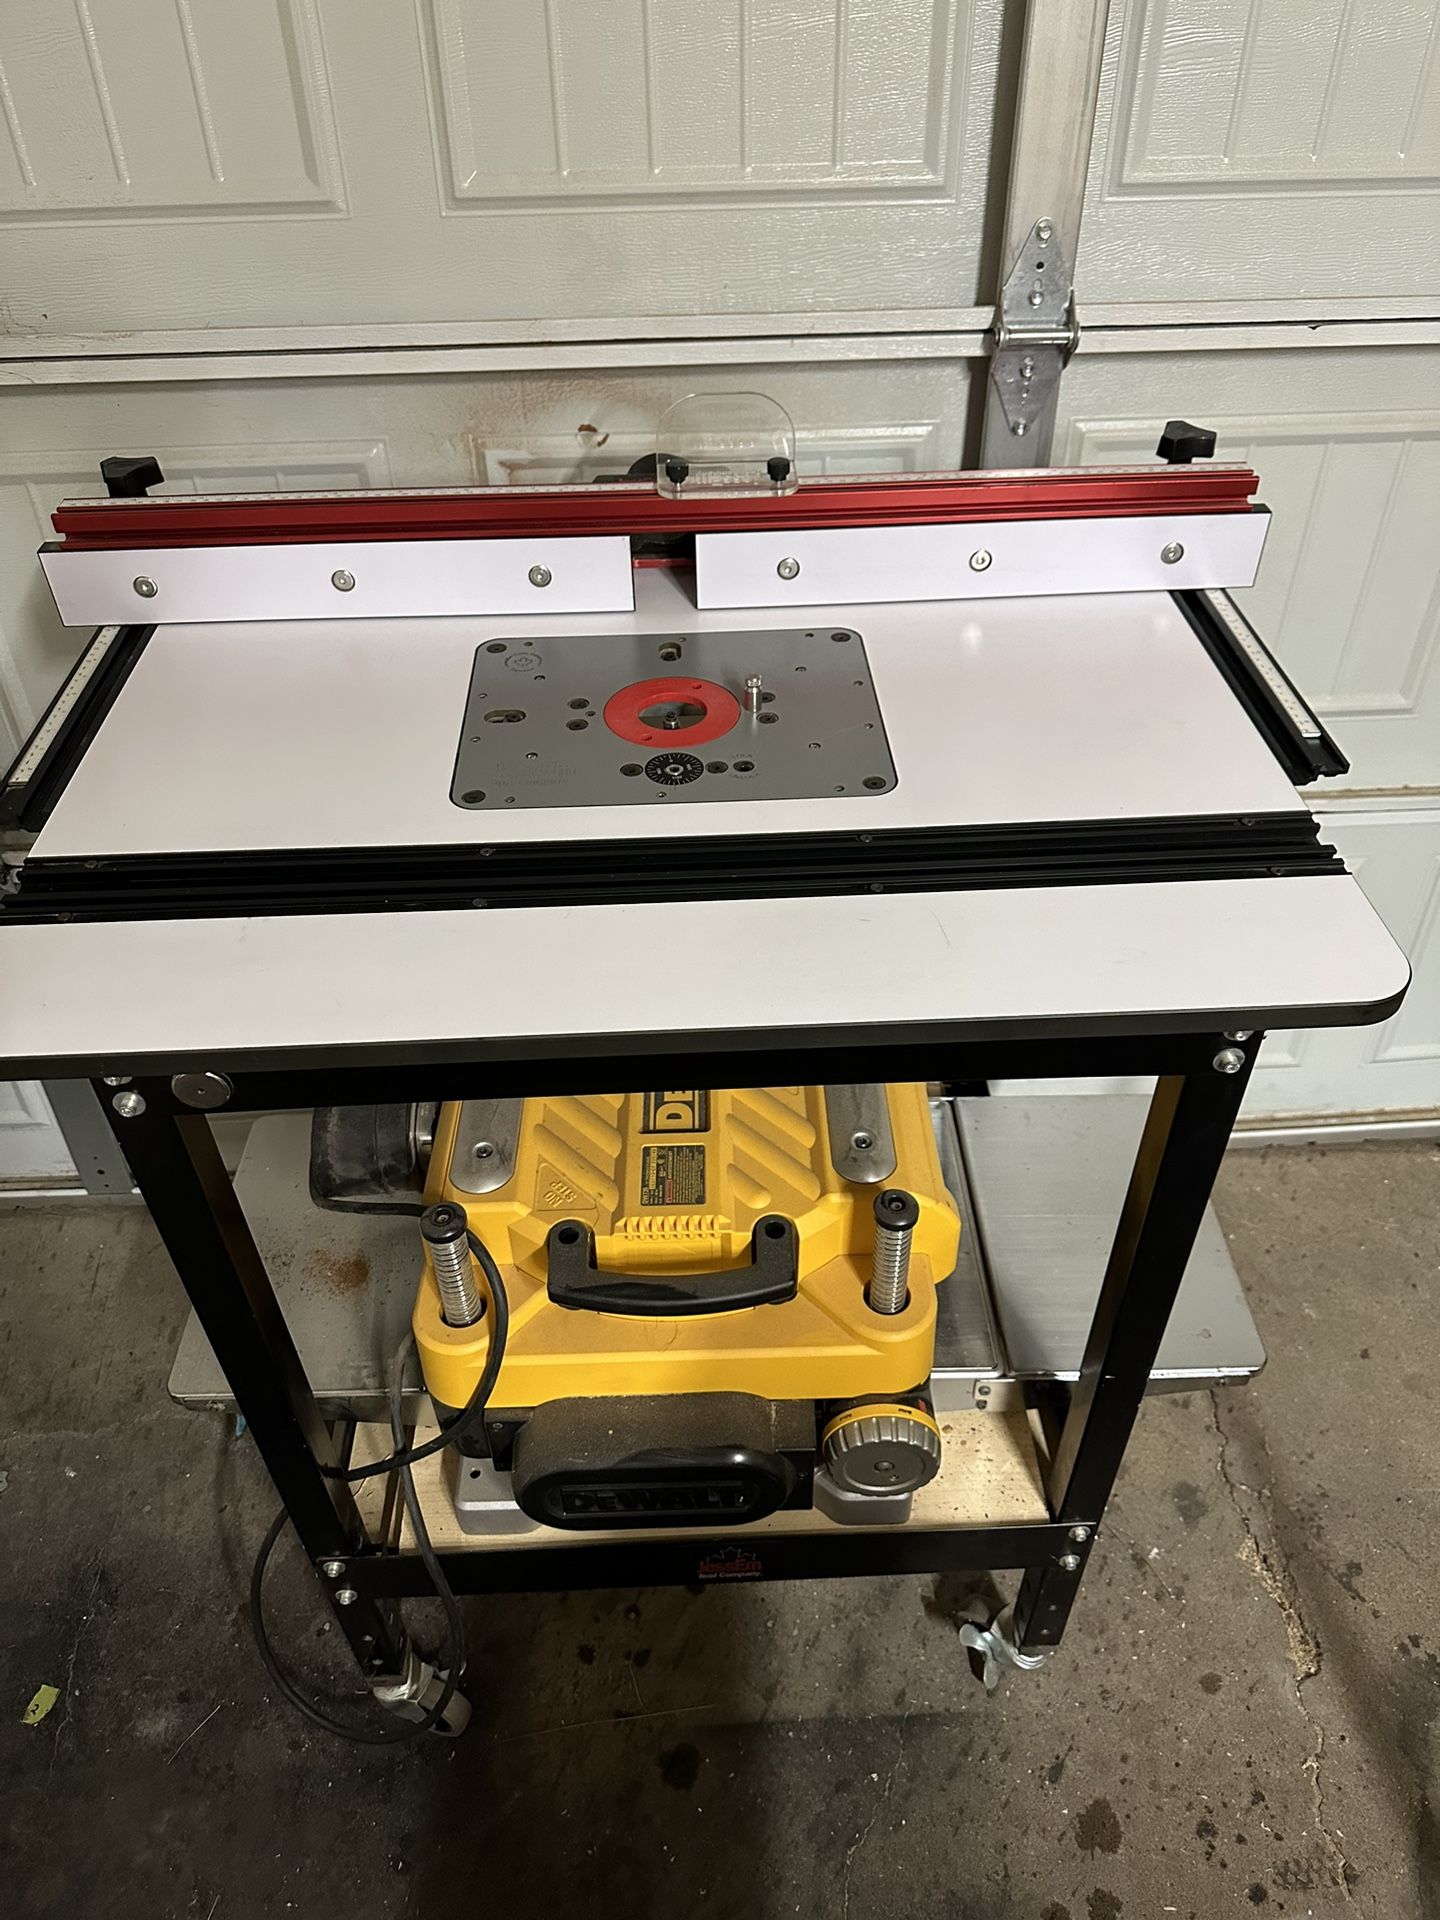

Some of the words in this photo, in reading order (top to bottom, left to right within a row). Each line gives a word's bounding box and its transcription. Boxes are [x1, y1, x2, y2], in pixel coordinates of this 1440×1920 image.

[543, 1191, 563, 1208] NO
[549, 1181, 577, 1203] STEP
[30, 1703, 40, 1716] 2
